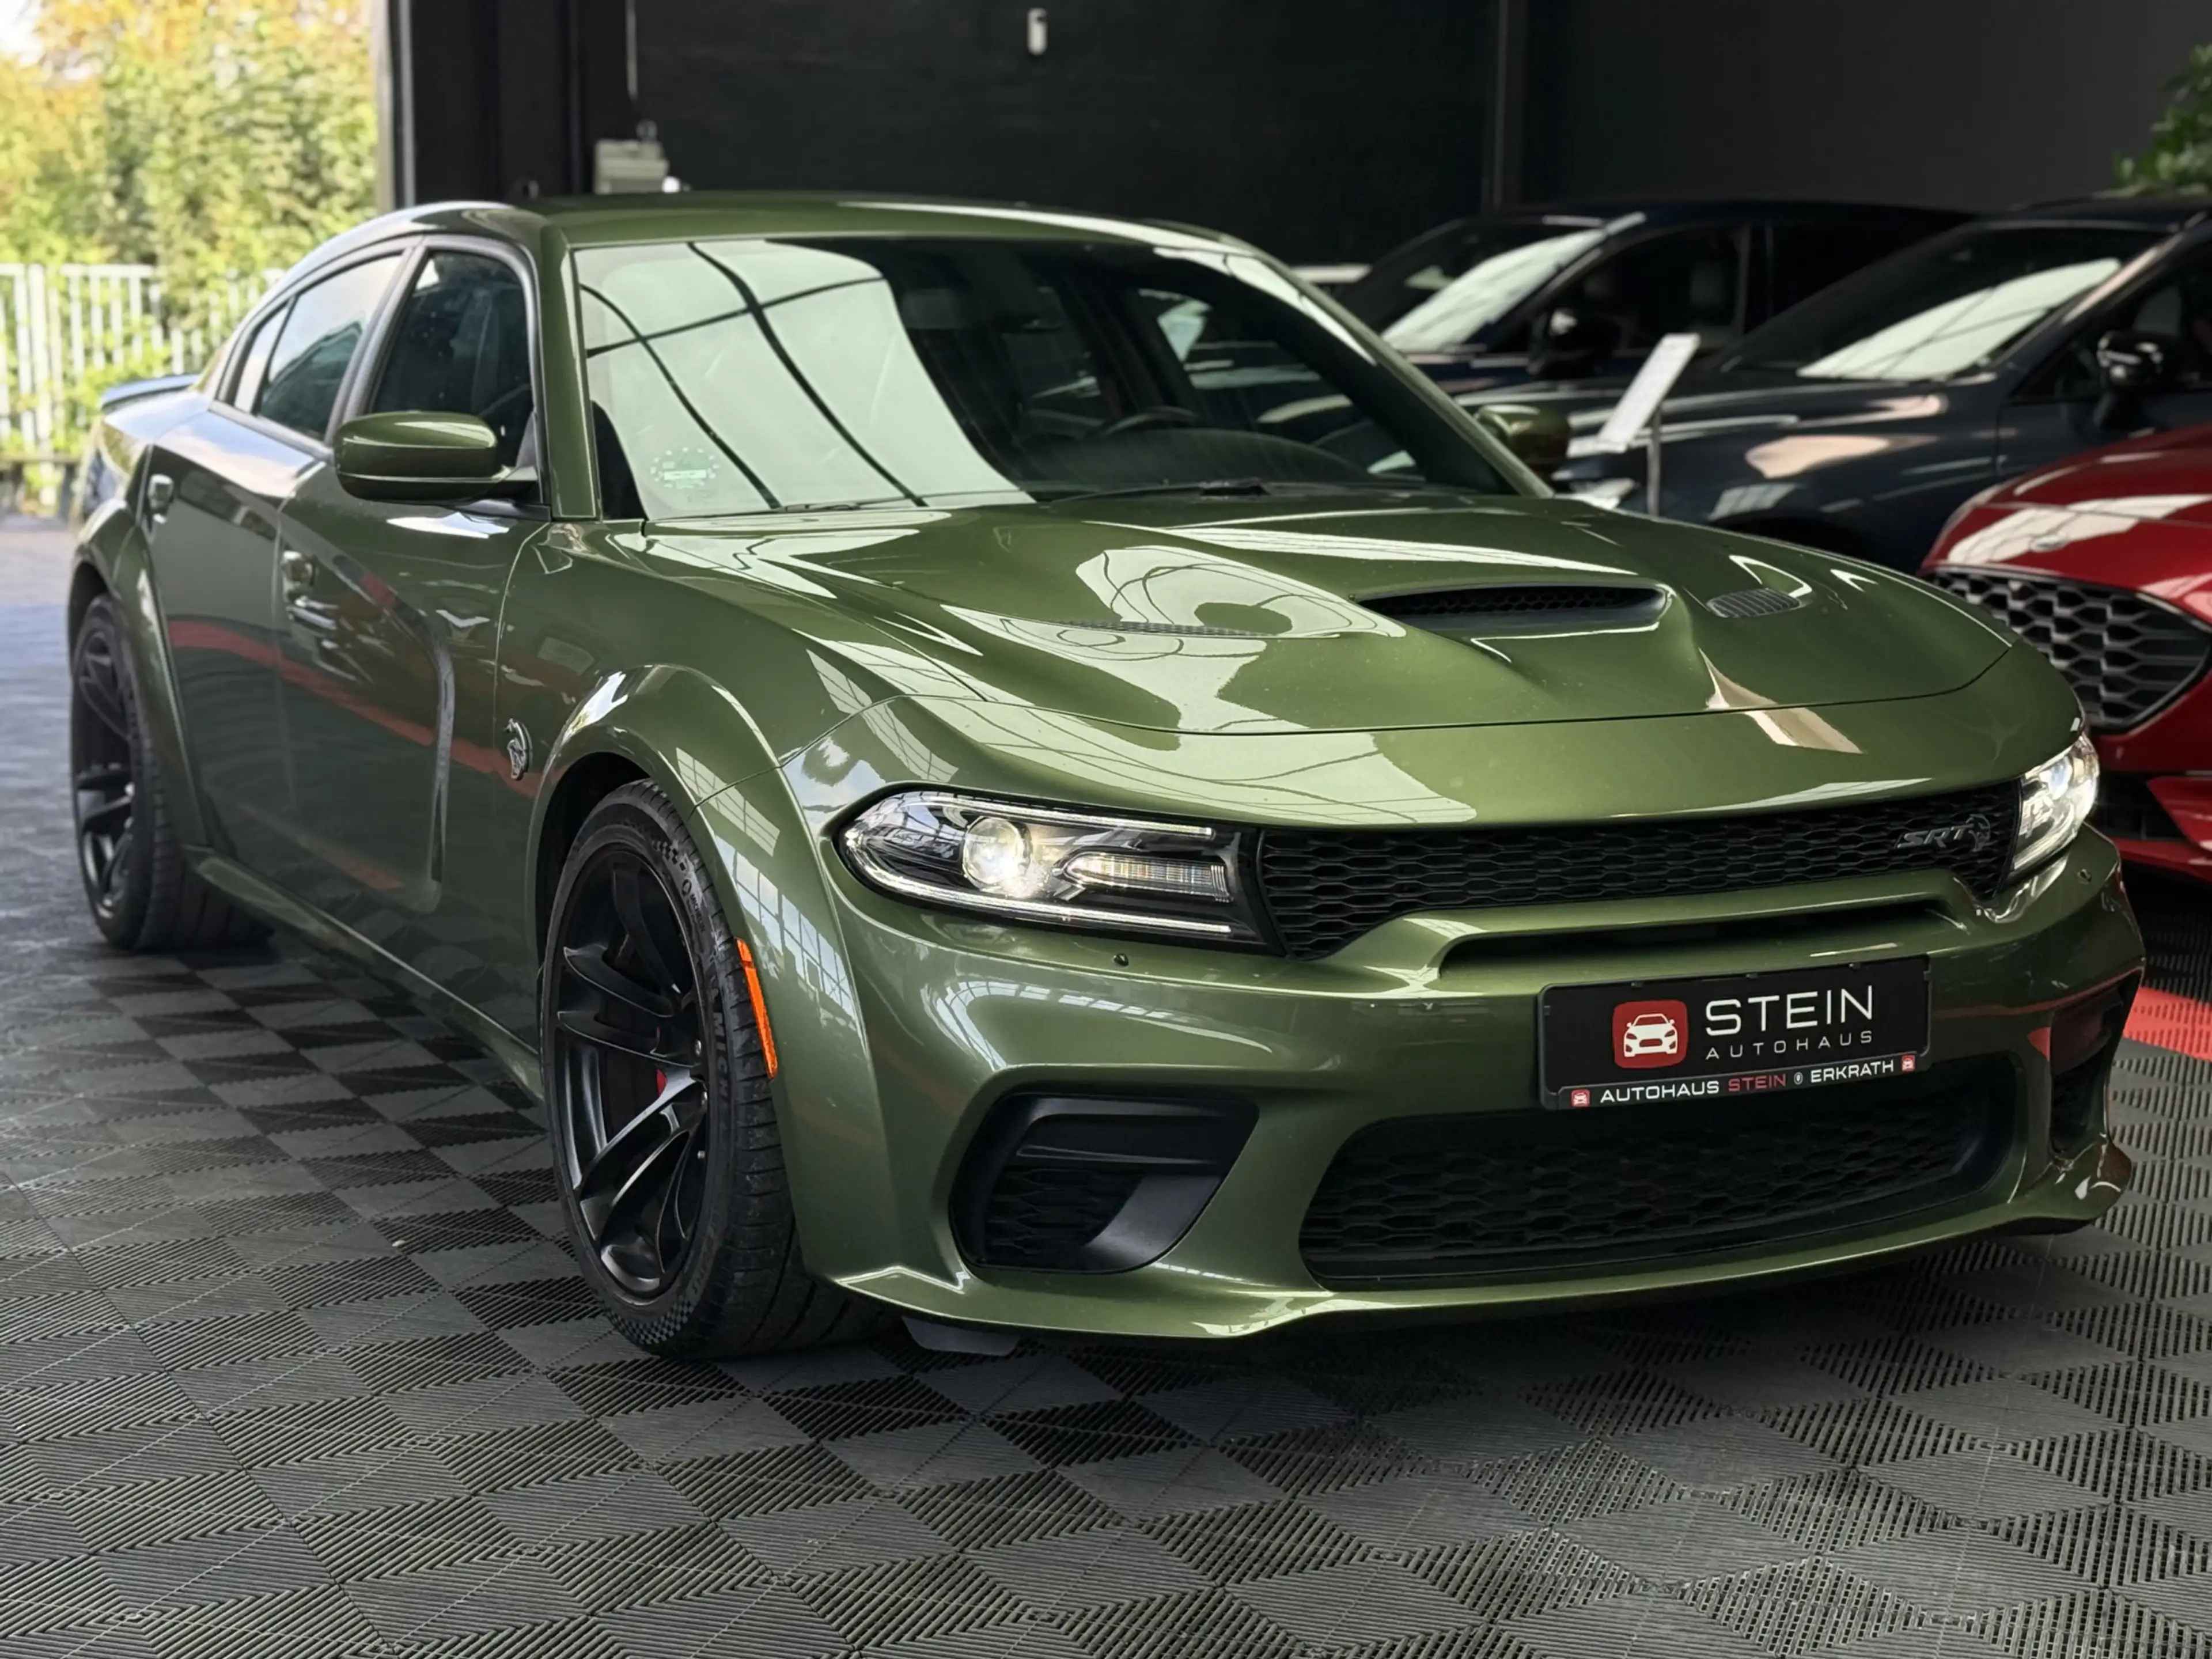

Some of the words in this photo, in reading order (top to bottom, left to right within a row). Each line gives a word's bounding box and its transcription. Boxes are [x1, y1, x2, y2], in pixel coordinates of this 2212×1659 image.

[1897, 824, 1974, 849] SRT
[1706, 986, 1873, 1036] STEIN
[1705, 1030, 1872, 1060] AUTOHAUS
[1600, 1080, 1719, 1104] AUTOHAUS
[1728, 1074, 1786, 1092] STEIN
[1810, 1059, 1894, 1084] ERKRATH
